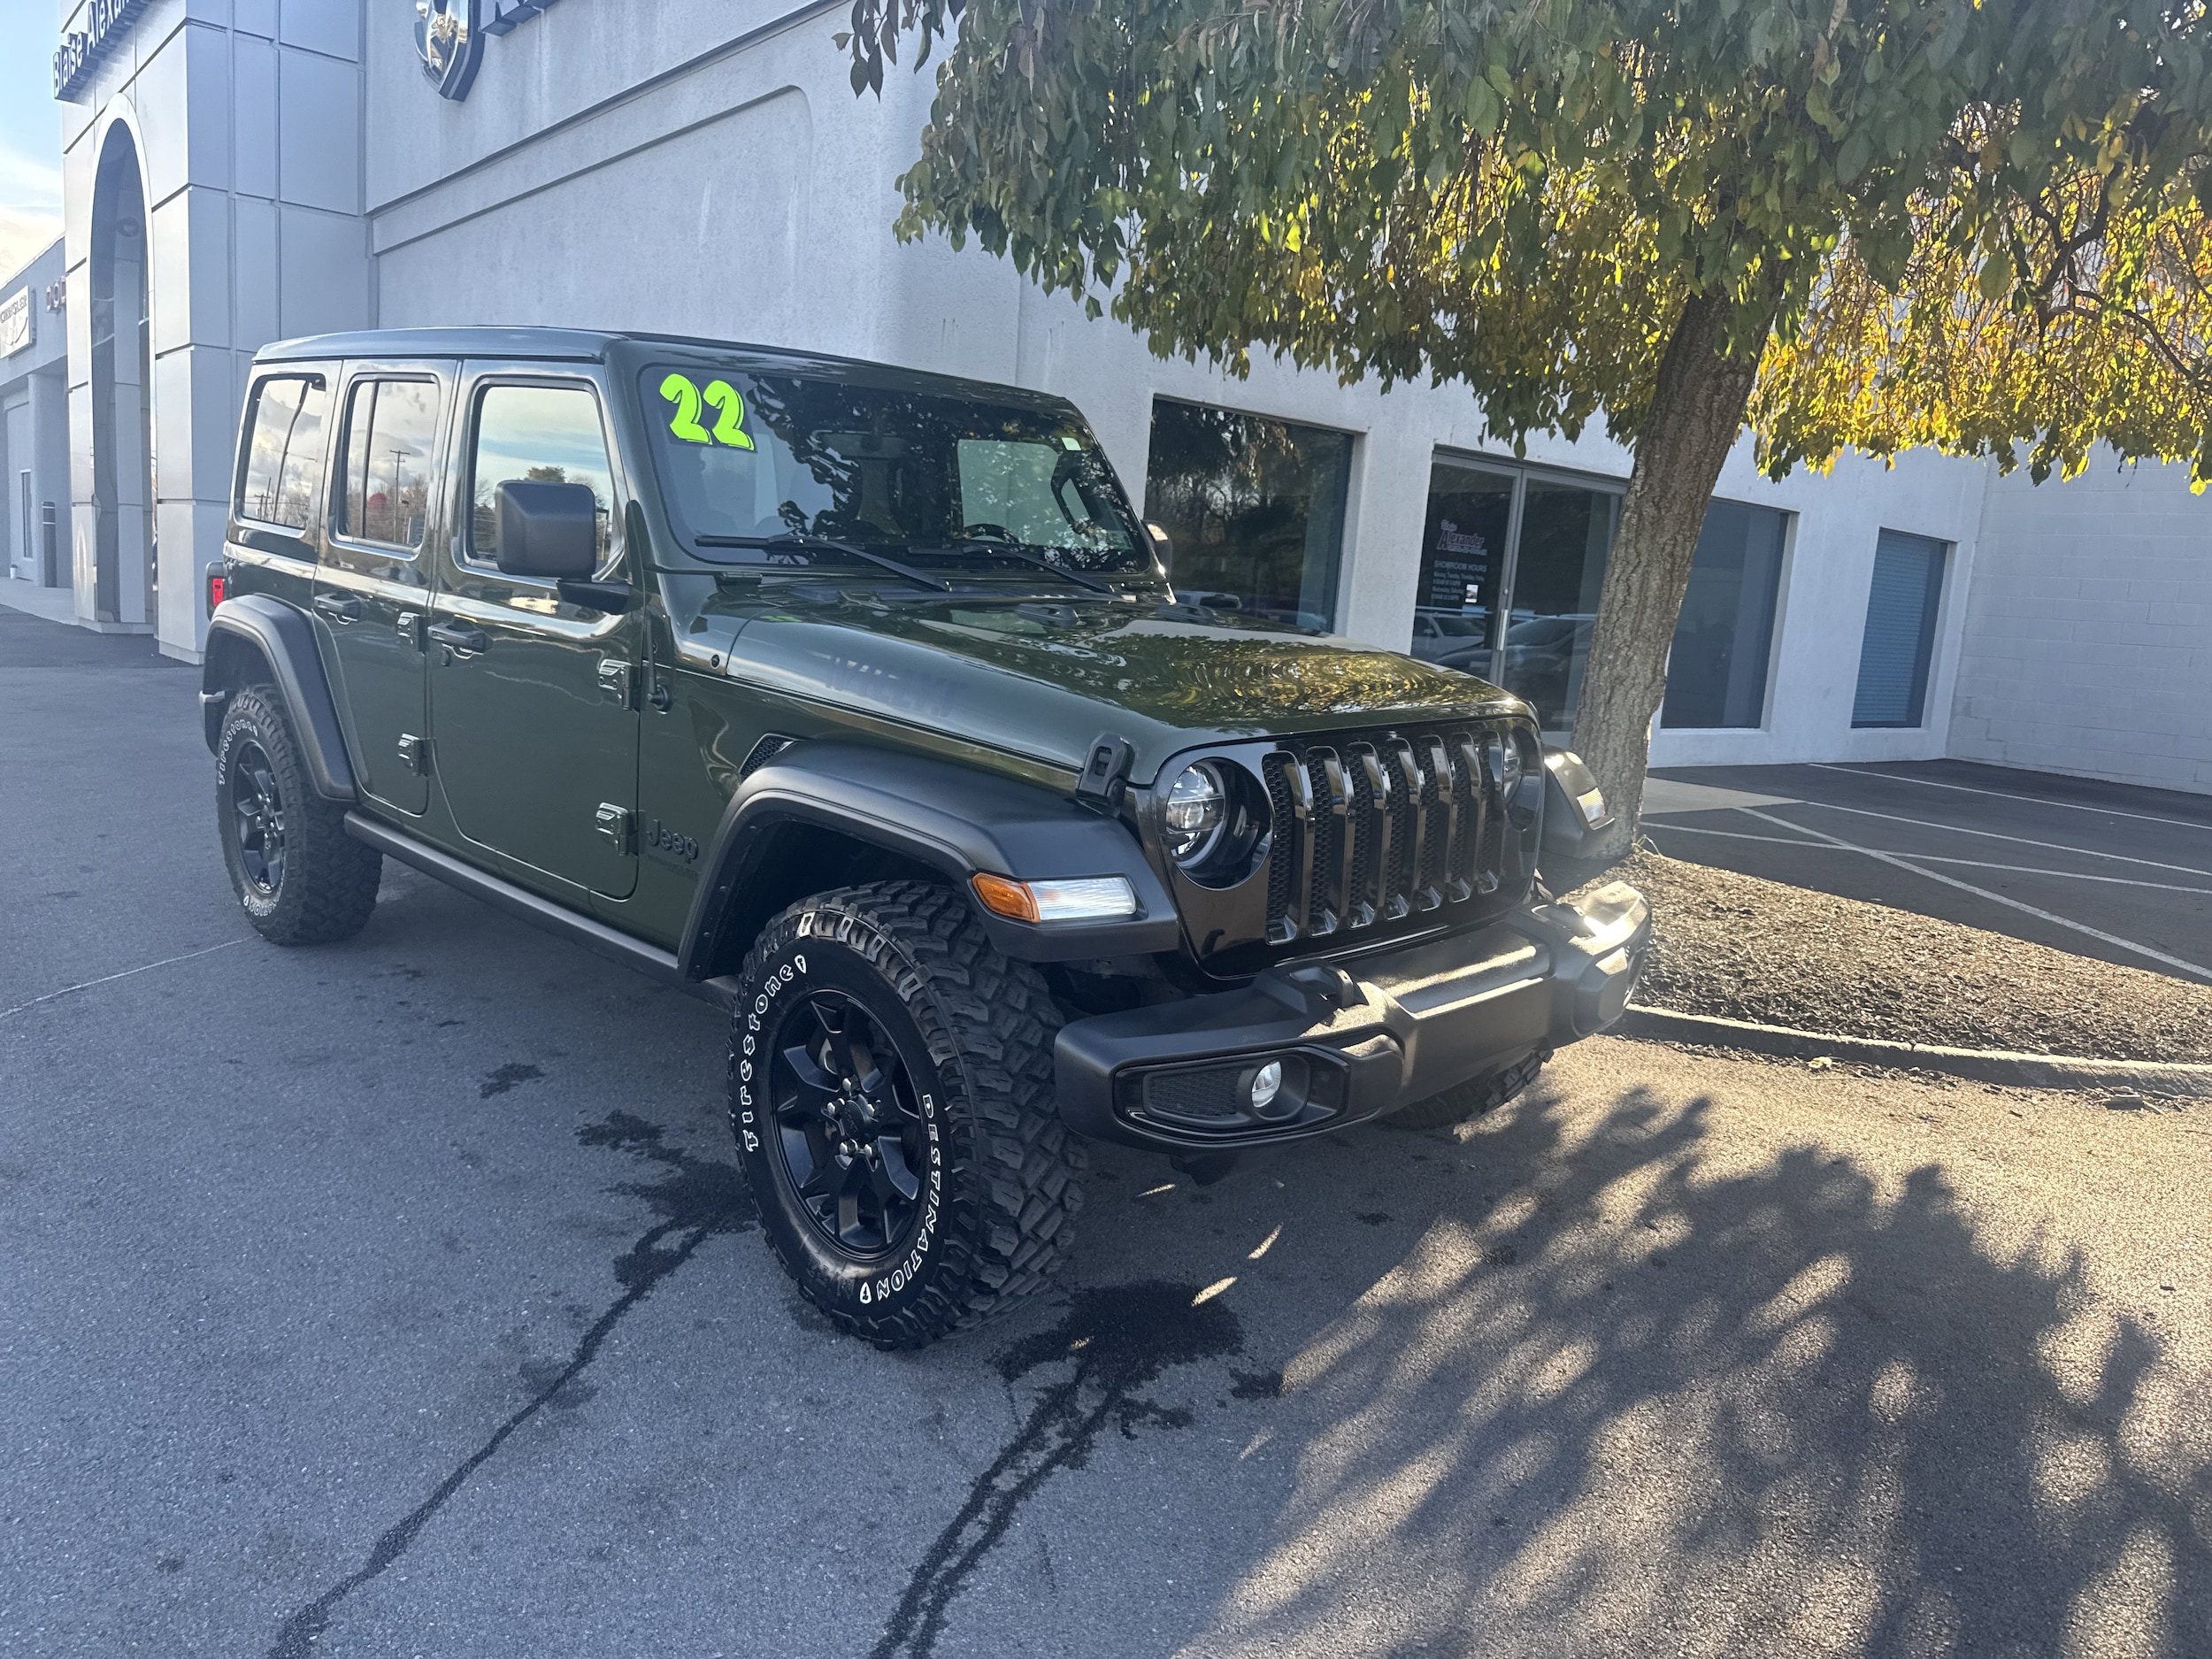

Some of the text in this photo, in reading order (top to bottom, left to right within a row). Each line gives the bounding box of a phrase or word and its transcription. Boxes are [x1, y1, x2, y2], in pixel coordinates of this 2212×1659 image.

[53, 31, 83, 98] Blaise
[659, 373, 755, 451] 22
[1433, 560, 1487, 572] SHOWROOM HOURS
[645, 818, 699, 864] Jeep
[876, 1094, 942, 1302] DESTINATION
